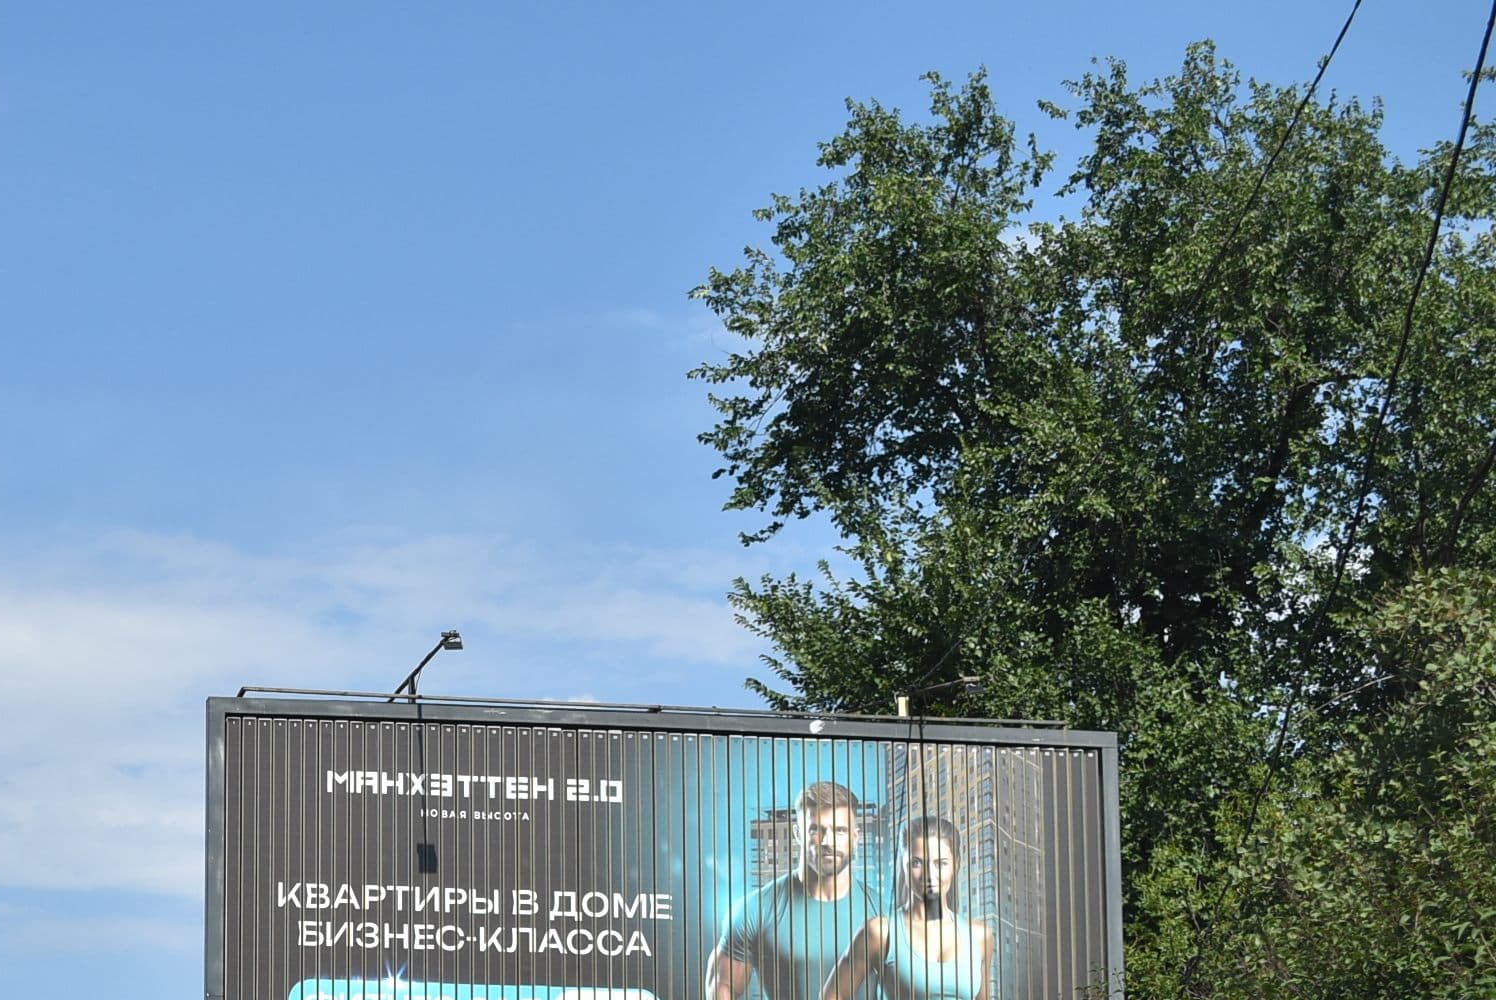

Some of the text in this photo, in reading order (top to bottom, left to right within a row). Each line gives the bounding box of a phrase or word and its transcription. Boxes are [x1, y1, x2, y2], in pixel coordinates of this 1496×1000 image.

[326, 769, 623, 803] МАНХЭТТЕН 2.0
[420, 808, 530, 822] НОВАЯ ВЫСОТА
[276, 882, 674, 922] КВАРТИРЫ В ДОМЕ
[297, 920, 653, 957] БИЗНЕС-КЛАССА
